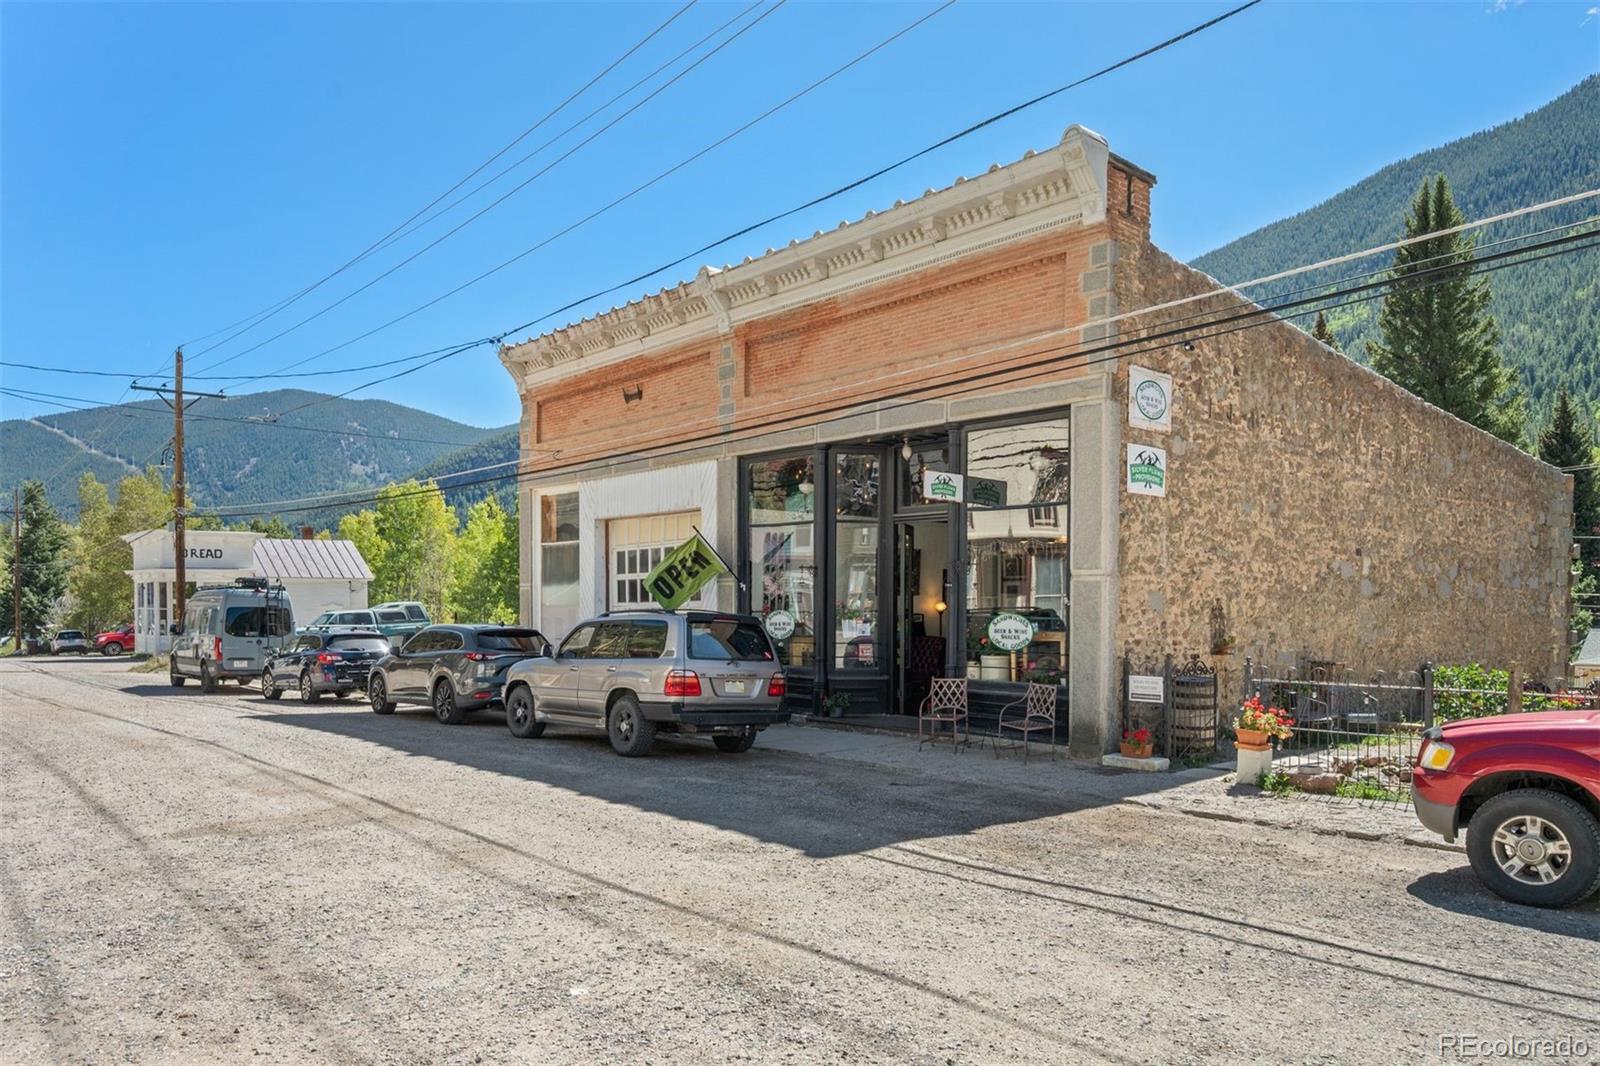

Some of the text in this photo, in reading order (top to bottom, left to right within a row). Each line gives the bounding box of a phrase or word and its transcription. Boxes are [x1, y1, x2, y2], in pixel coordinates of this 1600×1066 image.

[653, 550, 712, 599] OPEN
[992, 615, 1029, 628] SANDWICHES
[991, 634, 1029, 649] LOCAL GOODS
